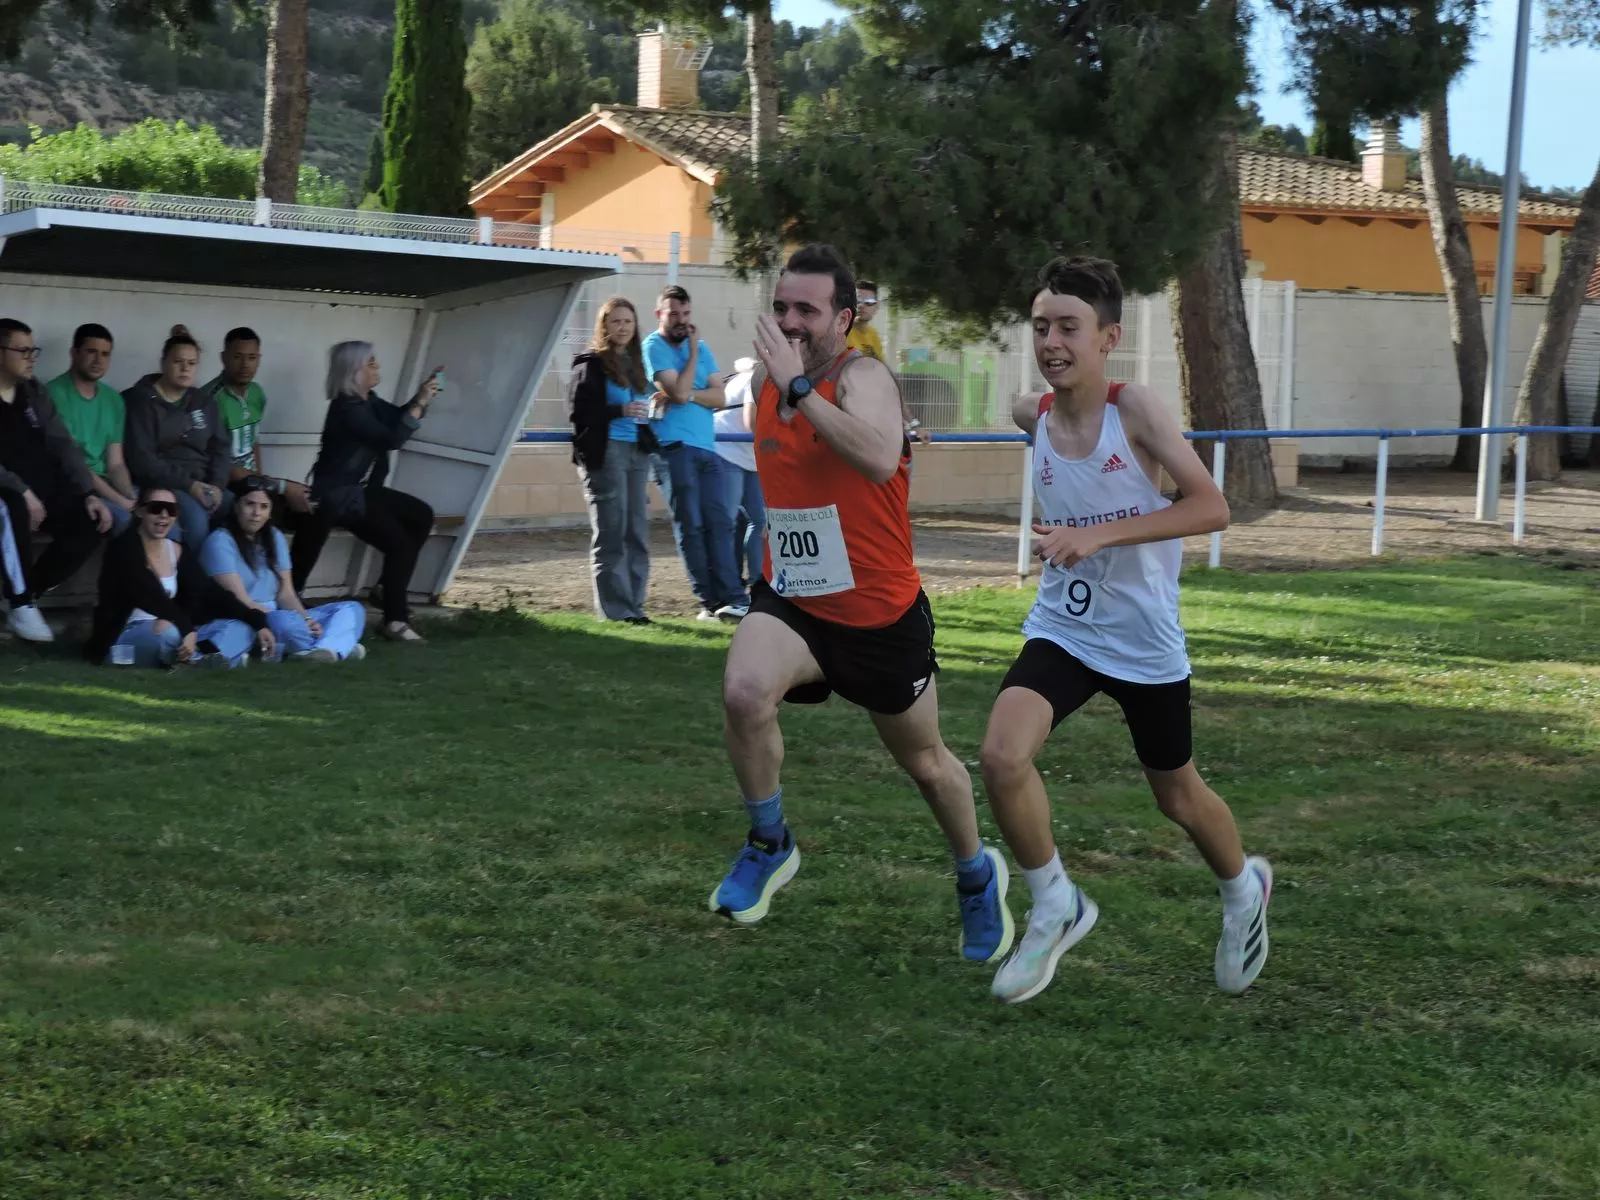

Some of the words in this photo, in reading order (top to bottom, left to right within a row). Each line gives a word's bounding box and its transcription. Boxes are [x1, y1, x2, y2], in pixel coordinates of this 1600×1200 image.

[1101, 463, 1128, 474] adidas
[775, 512, 797, 523] CURSA
[798, 512, 808, 522] DE
[811, 510, 833, 522] L'OLI
[777, 530, 820, 559] 200
[787, 577, 828, 588] aritmos
[1065, 579, 1092, 617] 9
